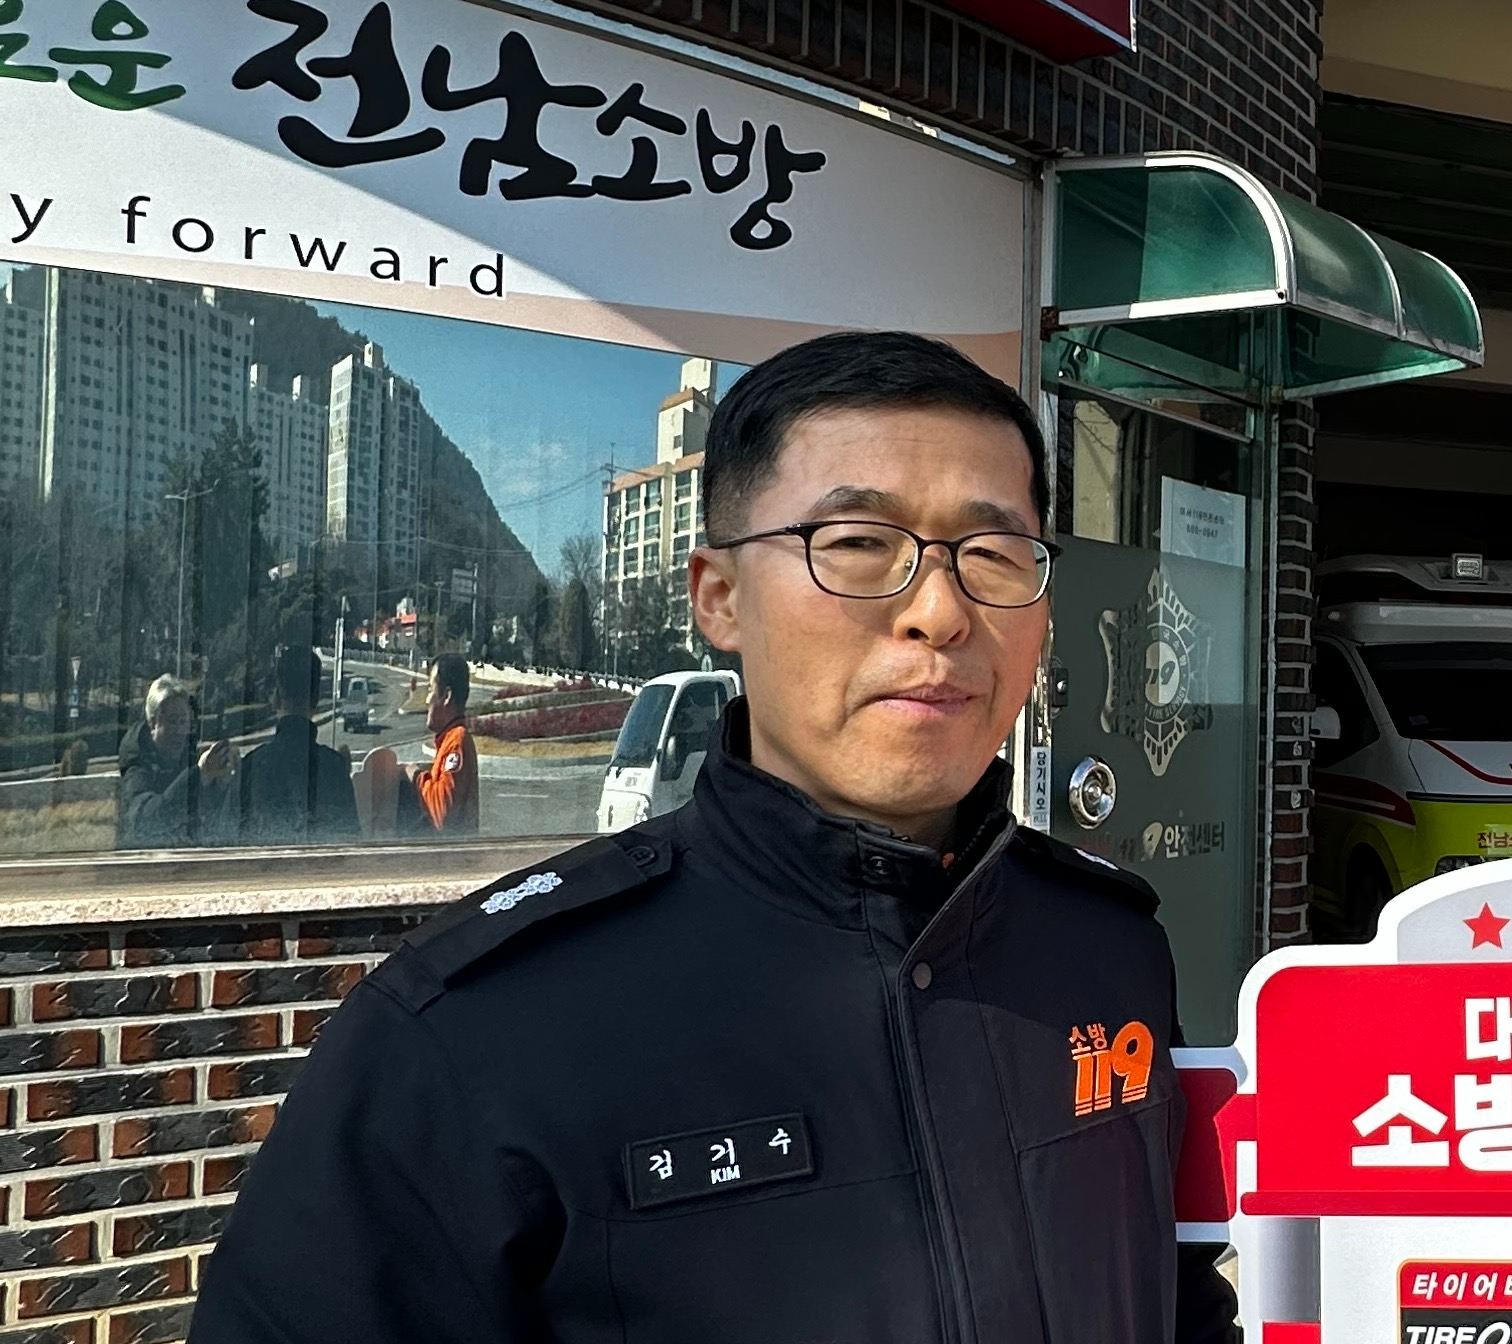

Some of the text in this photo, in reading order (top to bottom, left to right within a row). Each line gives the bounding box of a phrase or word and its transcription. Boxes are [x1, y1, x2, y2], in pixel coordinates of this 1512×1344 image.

[122, 196, 506, 298] forward
[1036, 751, 1047, 810] 당기시오
[1069, 1022, 1108, 1055] 소방
[1072, 1020, 1154, 1117] 119
